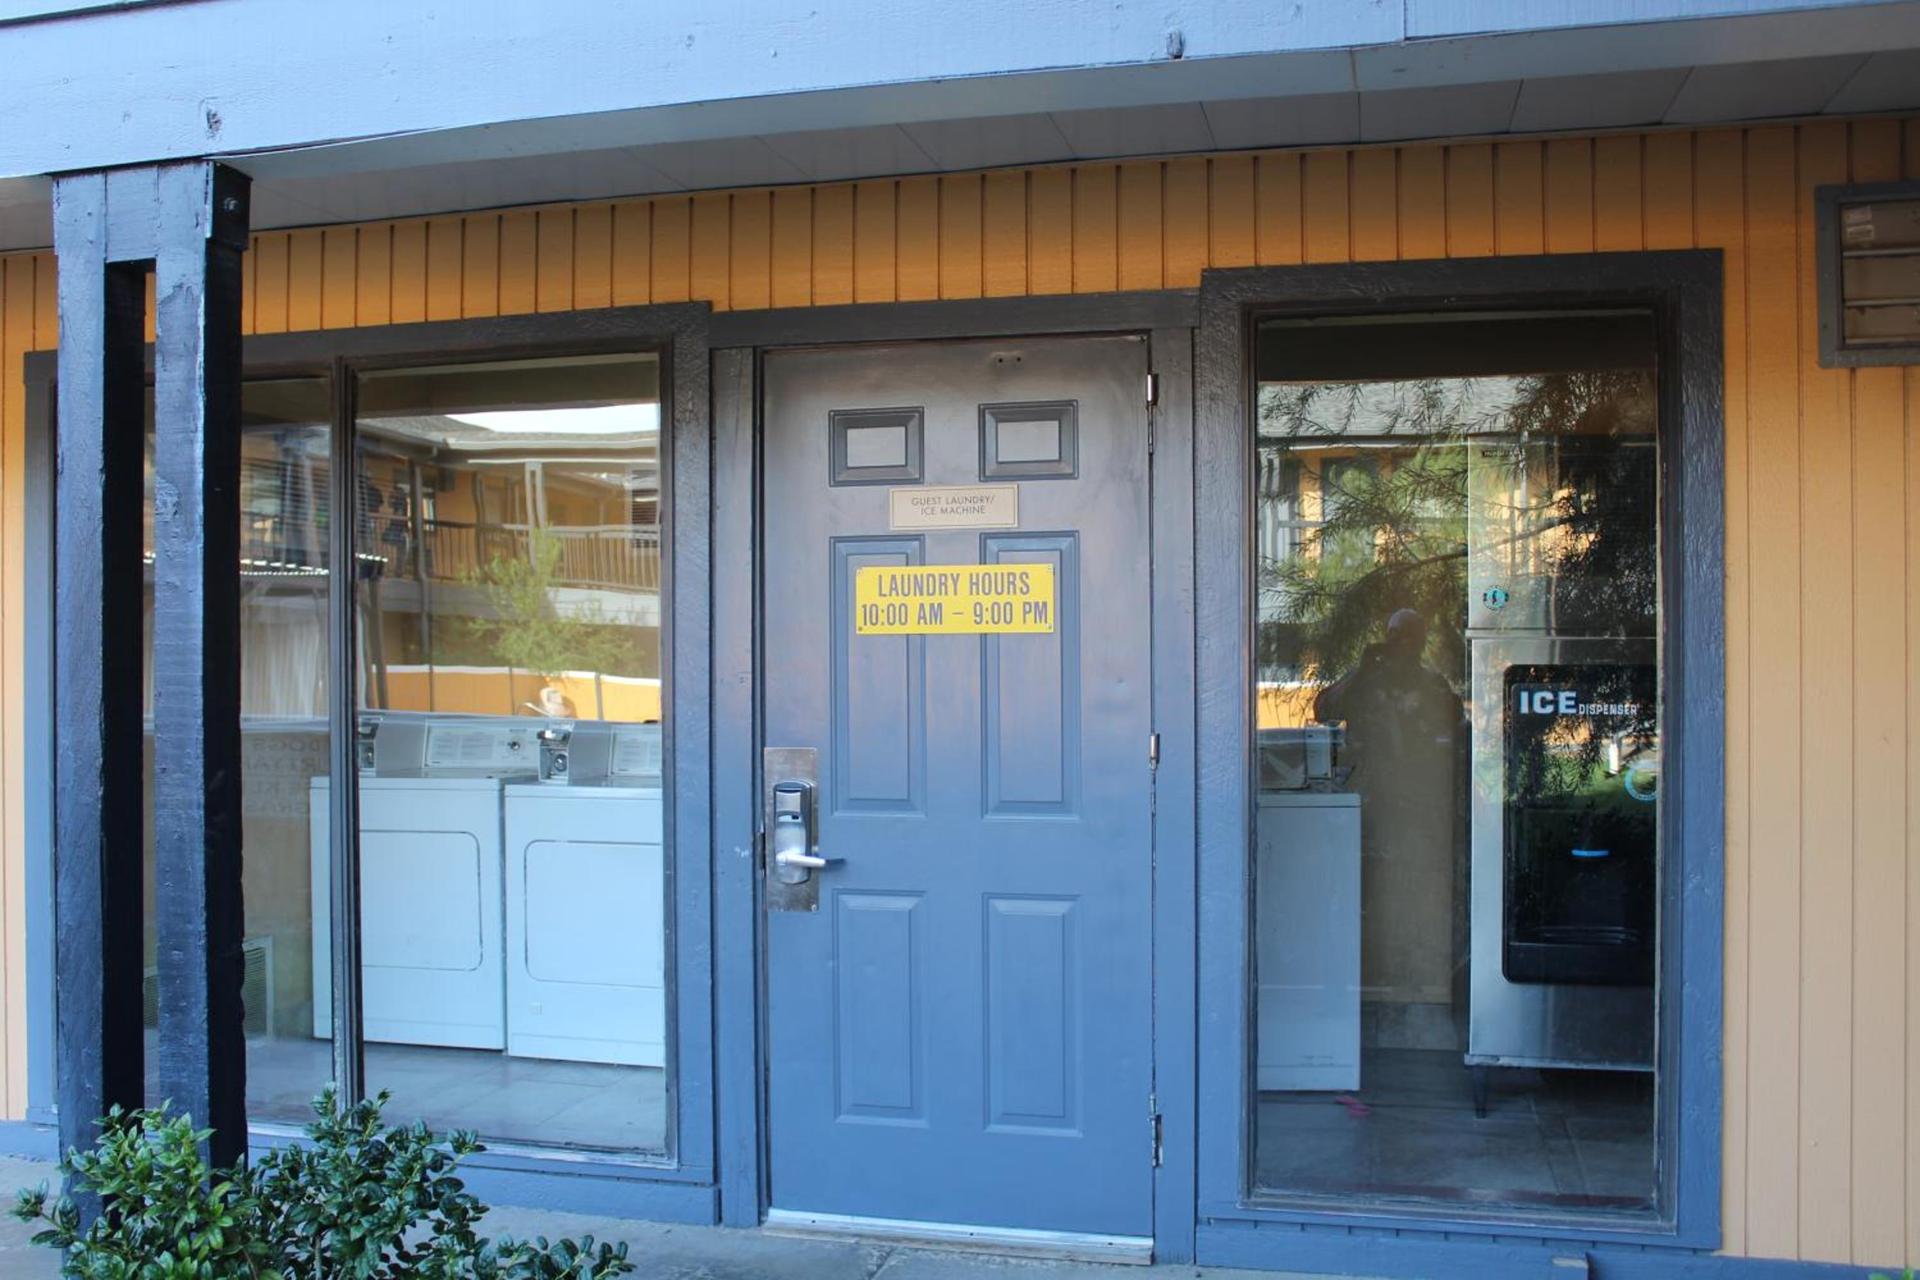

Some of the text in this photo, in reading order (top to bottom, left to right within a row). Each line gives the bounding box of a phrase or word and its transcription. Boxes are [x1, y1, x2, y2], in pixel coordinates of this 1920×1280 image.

[911, 495, 995, 506] GUEST LAUNDRY/
[920, 505, 985, 516] ICE MACHINE
[878, 571, 1030, 597] LAUNDRY HOURS
[861, 603, 908, 626] 10:00
[917, 602, 943, 625] AM
[973, 601, 1013, 625] 9:00
[1022, 601, 1048, 624] PM
[1520, 690, 1637, 715] ICE DISPENSER
